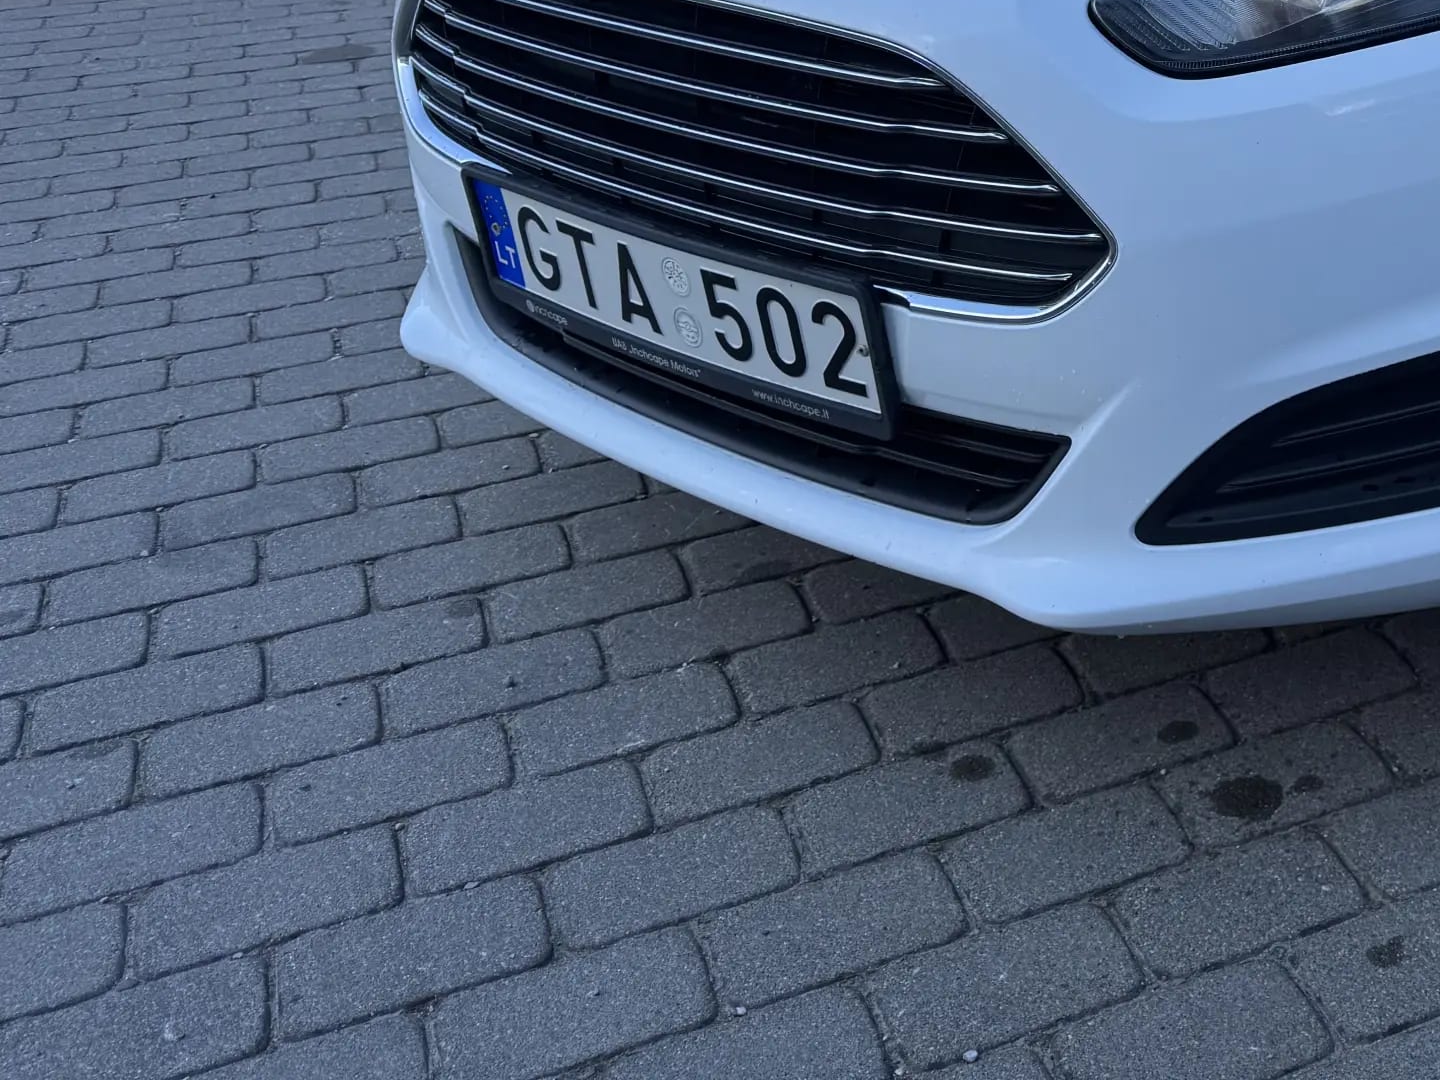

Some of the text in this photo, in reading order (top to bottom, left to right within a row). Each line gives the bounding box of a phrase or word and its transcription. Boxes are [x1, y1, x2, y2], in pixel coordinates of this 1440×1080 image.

[494, 240, 517, 270] LT
[517, 205, 868, 398] GTA 502
